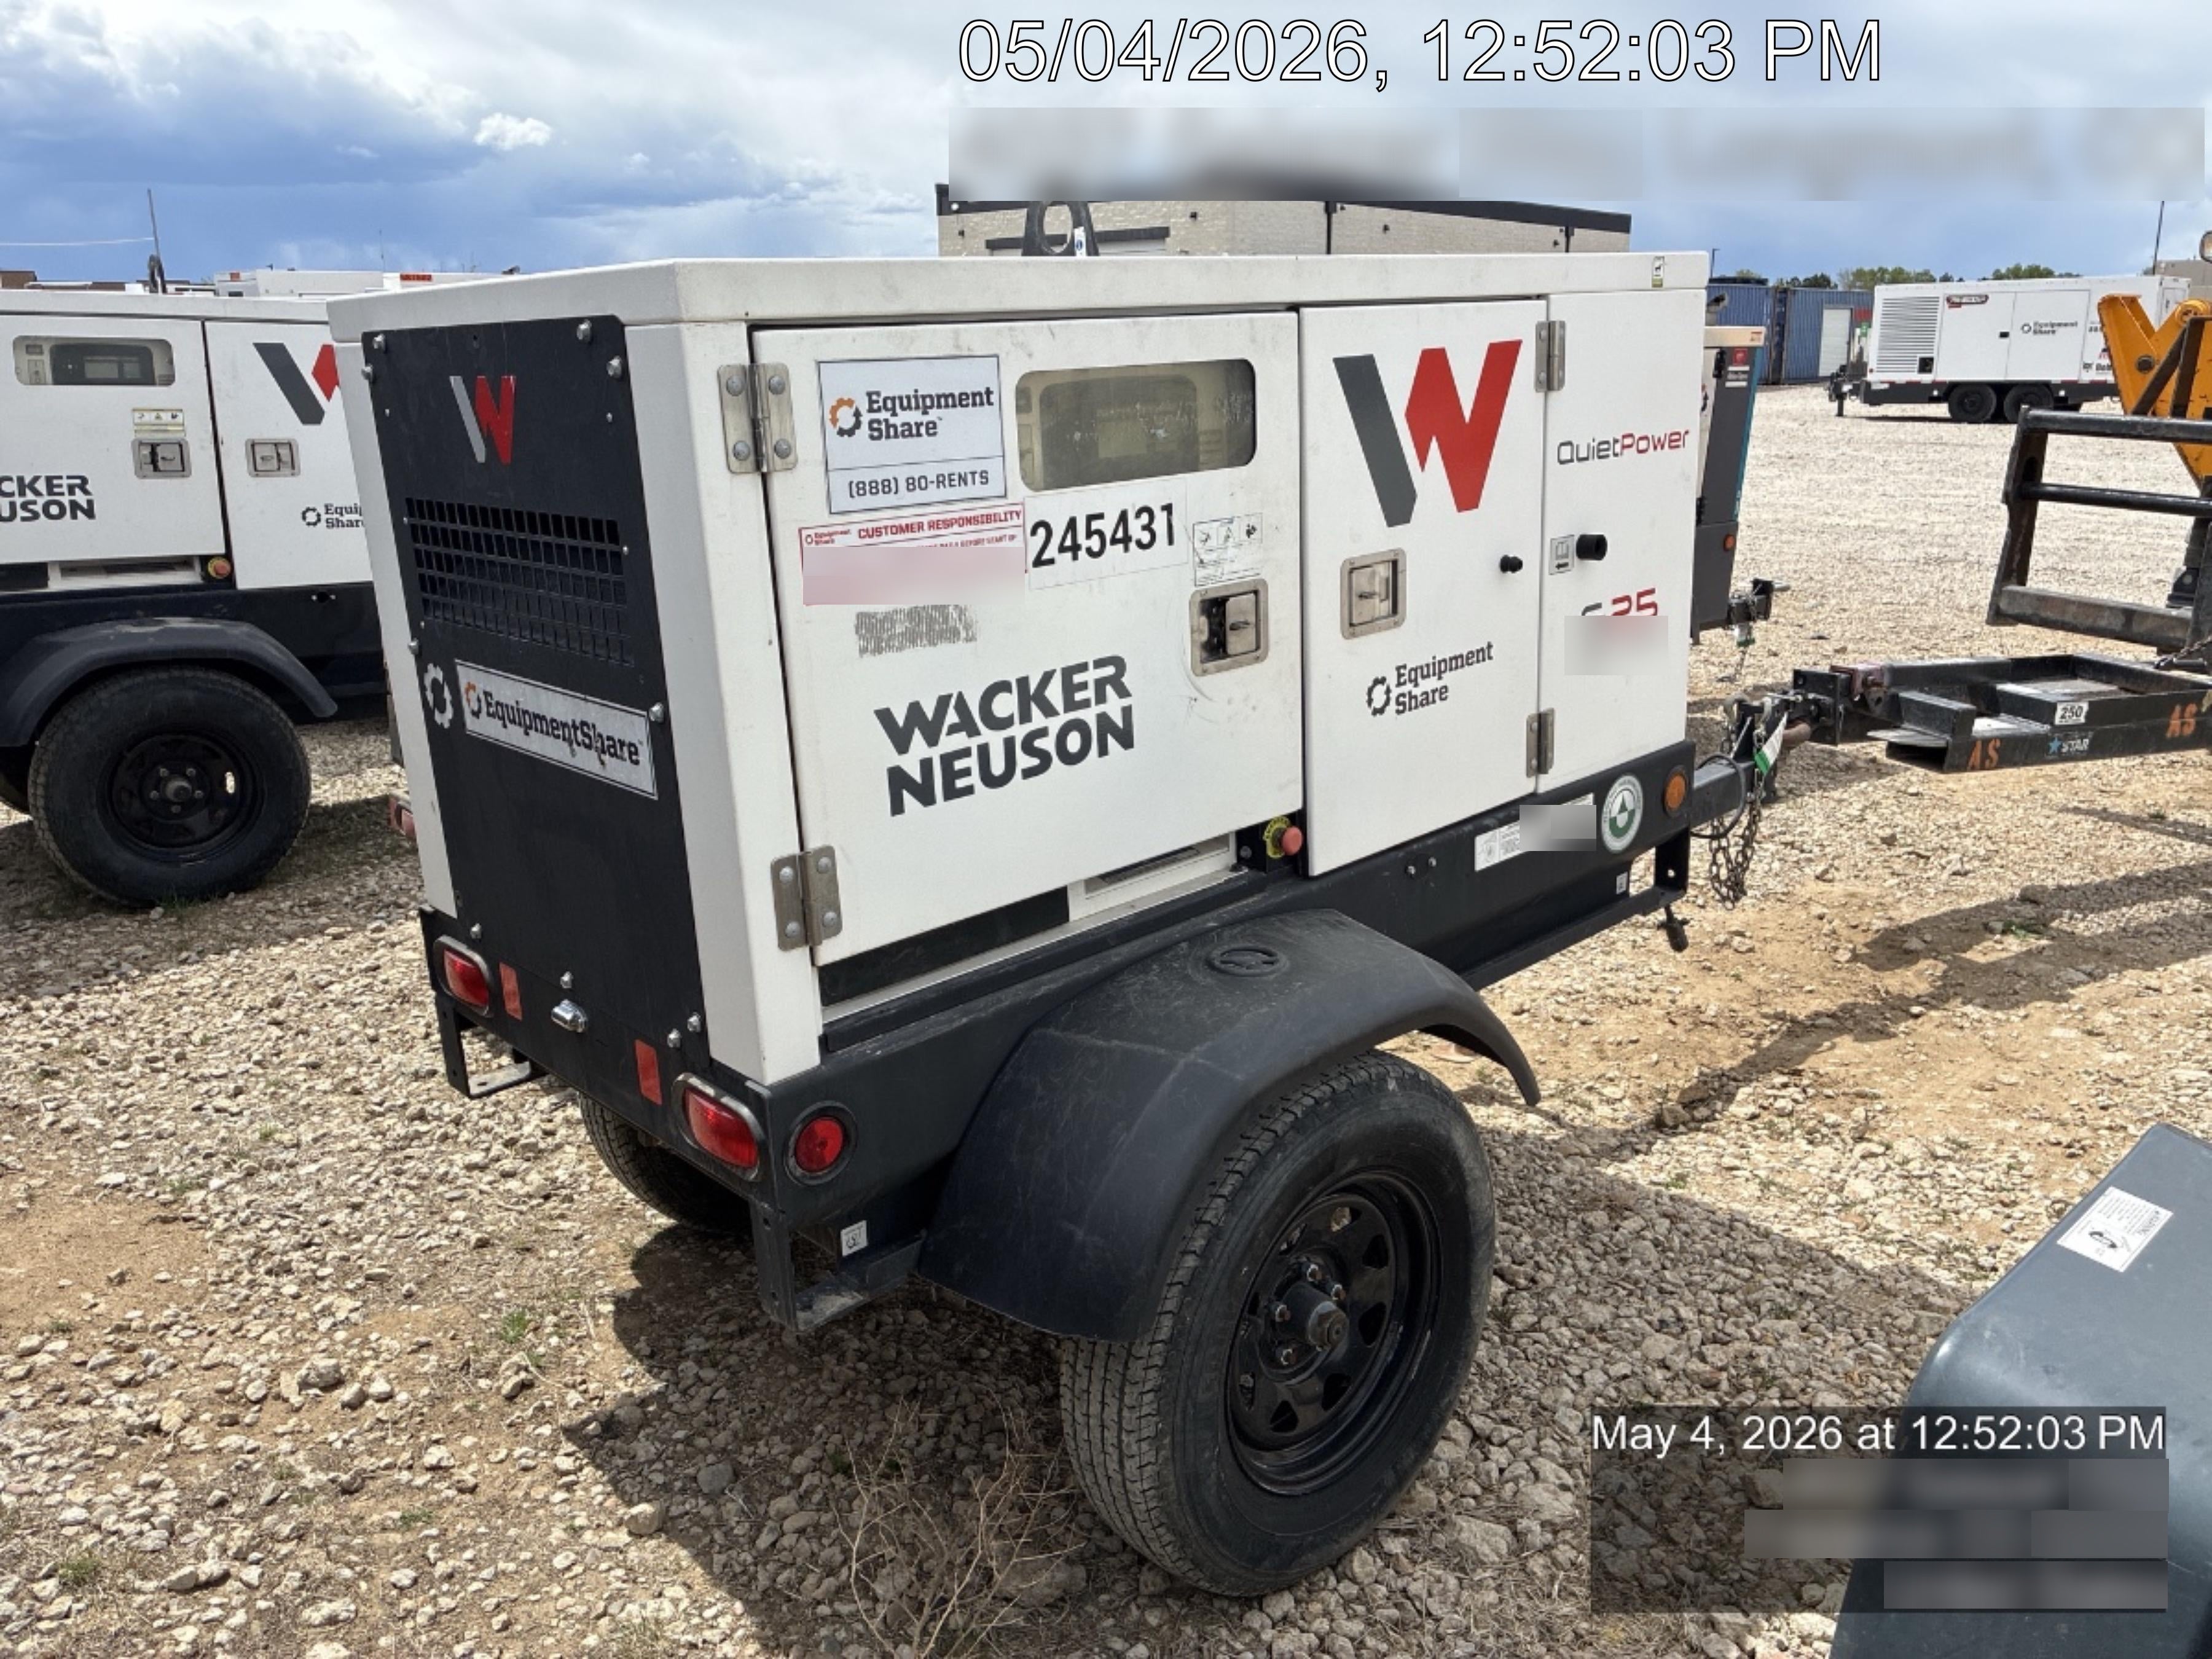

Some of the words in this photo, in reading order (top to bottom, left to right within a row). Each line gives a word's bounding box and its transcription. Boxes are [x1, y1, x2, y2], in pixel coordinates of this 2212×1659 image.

[866, 386, 994, 417] Equipment
[868, 418, 938, 441] Share
[1557, 429, 1689, 465] QuietPower
[848, 477, 899, 498] (888)
[905, 469, 989, 493] 80-RENTS
[858, 521, 925, 539] CUSTOMER
[927, 510, 1022, 531] RESPONSIBILITY
[1030, 503, 1174, 568] 245431
[1395, 641, 1493, 688] Equipment
[873, 655, 1132, 756] WACKER
[1395, 684, 1449, 715] Share
[2059, 705, 2084, 720] 250
[483, 689, 640, 766] EquipmentShare
[887, 704, 1134, 817] NEUSON
